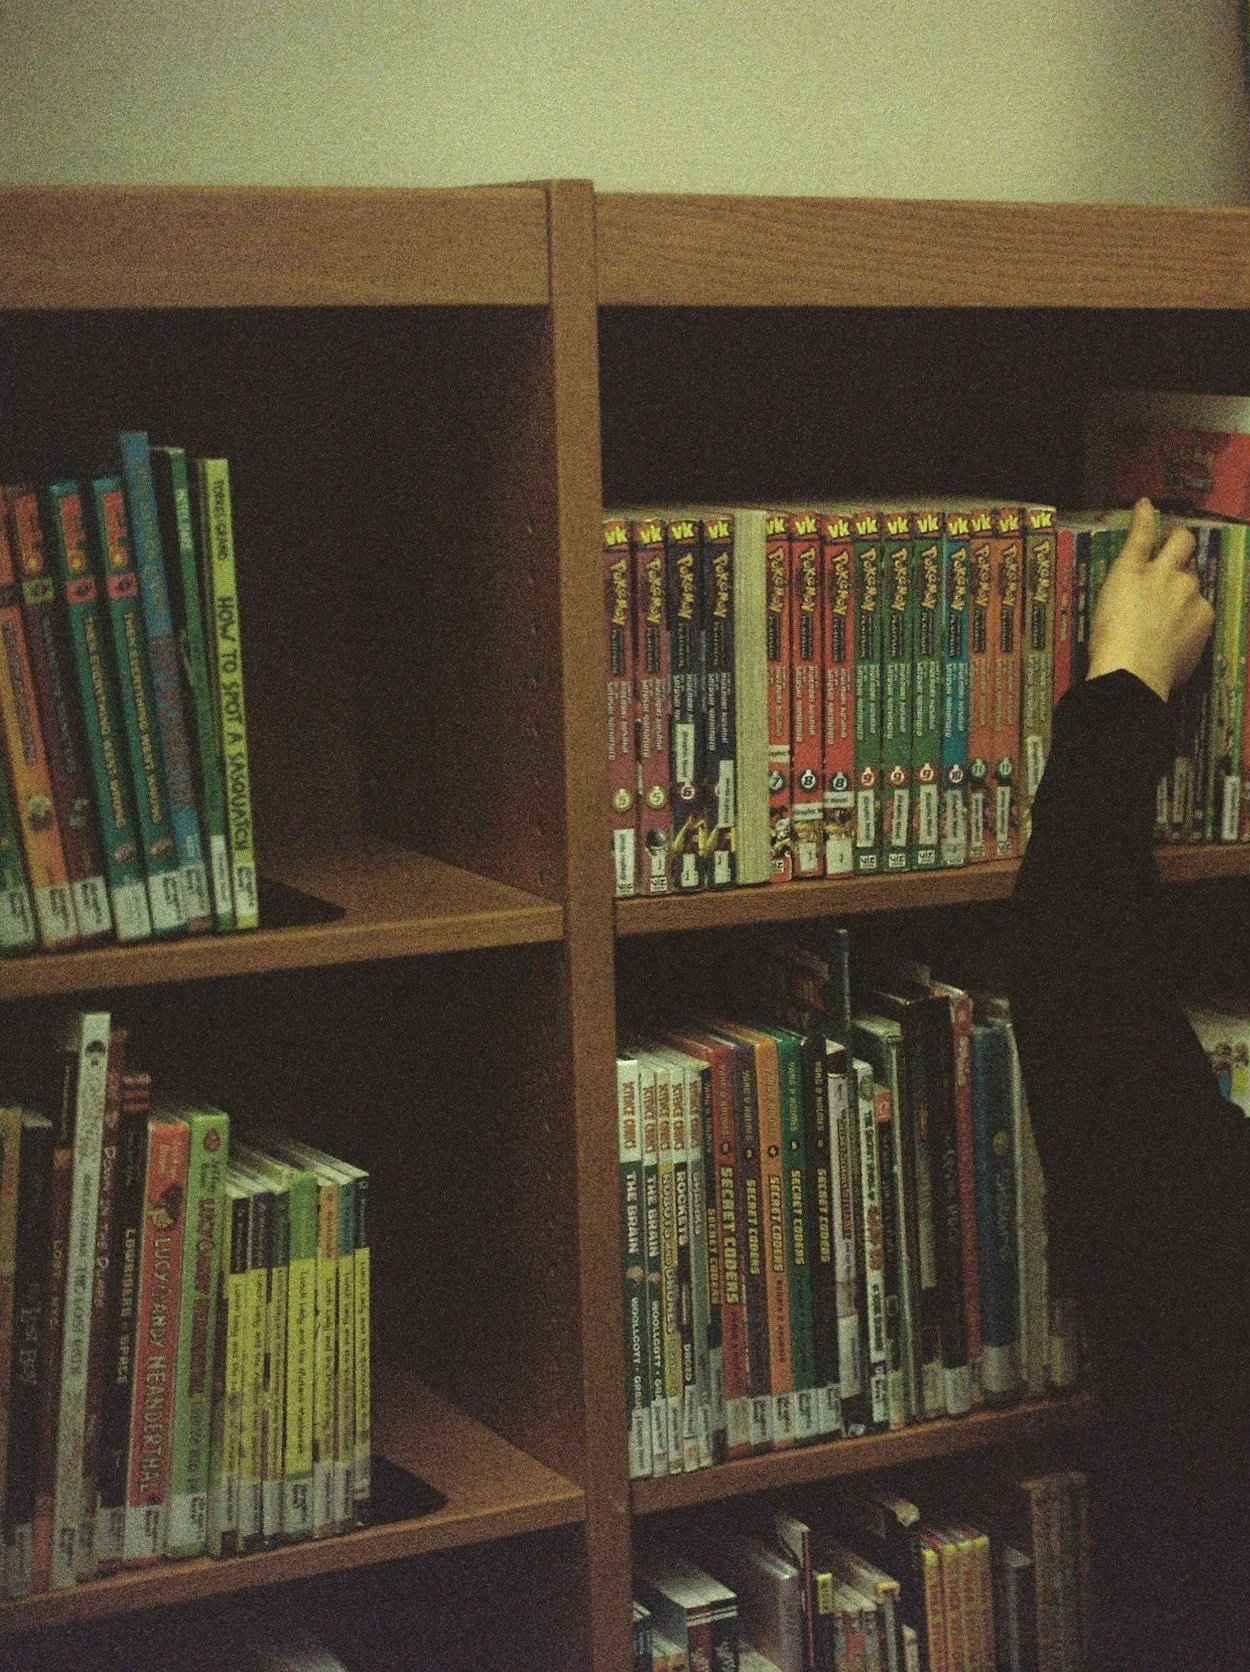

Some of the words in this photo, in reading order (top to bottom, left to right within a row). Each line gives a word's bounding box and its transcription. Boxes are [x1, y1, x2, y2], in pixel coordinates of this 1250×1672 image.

[217, 596, 237, 642] HOW
[221, 649, 238, 674] TO
[222, 682, 241, 722] SPOT
[227, 732, 241, 745] A
[228, 753, 250, 850] SASQUATCH
[623, 1081, 635, 1116] SCIENCE
[623, 1119, 636, 1150] COMICS
[626, 1171, 637, 1202] THE
[647, 1176, 657, 1205] THE
[662, 1172, 673, 1238] ROBOTS
[676, 1170, 688, 1247] ROCKETS
[721, 1167, 735, 1232] SECRET
[746, 1179, 757, 1223] SECRET
[769, 1177, 780, 1221] SECRET
[791, 1170, 803, 1214] SECRET
[626, 1205, 639, 1254] BRAIN
[648, 1208, 659, 1257] BRAIN
[748, 1228, 760, 1274] CODERS
[771, 1225, 783, 1272] CODERS
[793, 1218, 805, 1265] CODERS
[155, 1237, 171, 1281] LUCY
[724, 1237, 738, 1303] CODERS
[150, 1303, 168, 1348] ANDY
[631, 1297, 641, 1364] WOOLLCOTT
[651, 1300, 662, 1367] WOOLLCOTT
[139, 1356, 167, 1494] NEANDERTHAL
